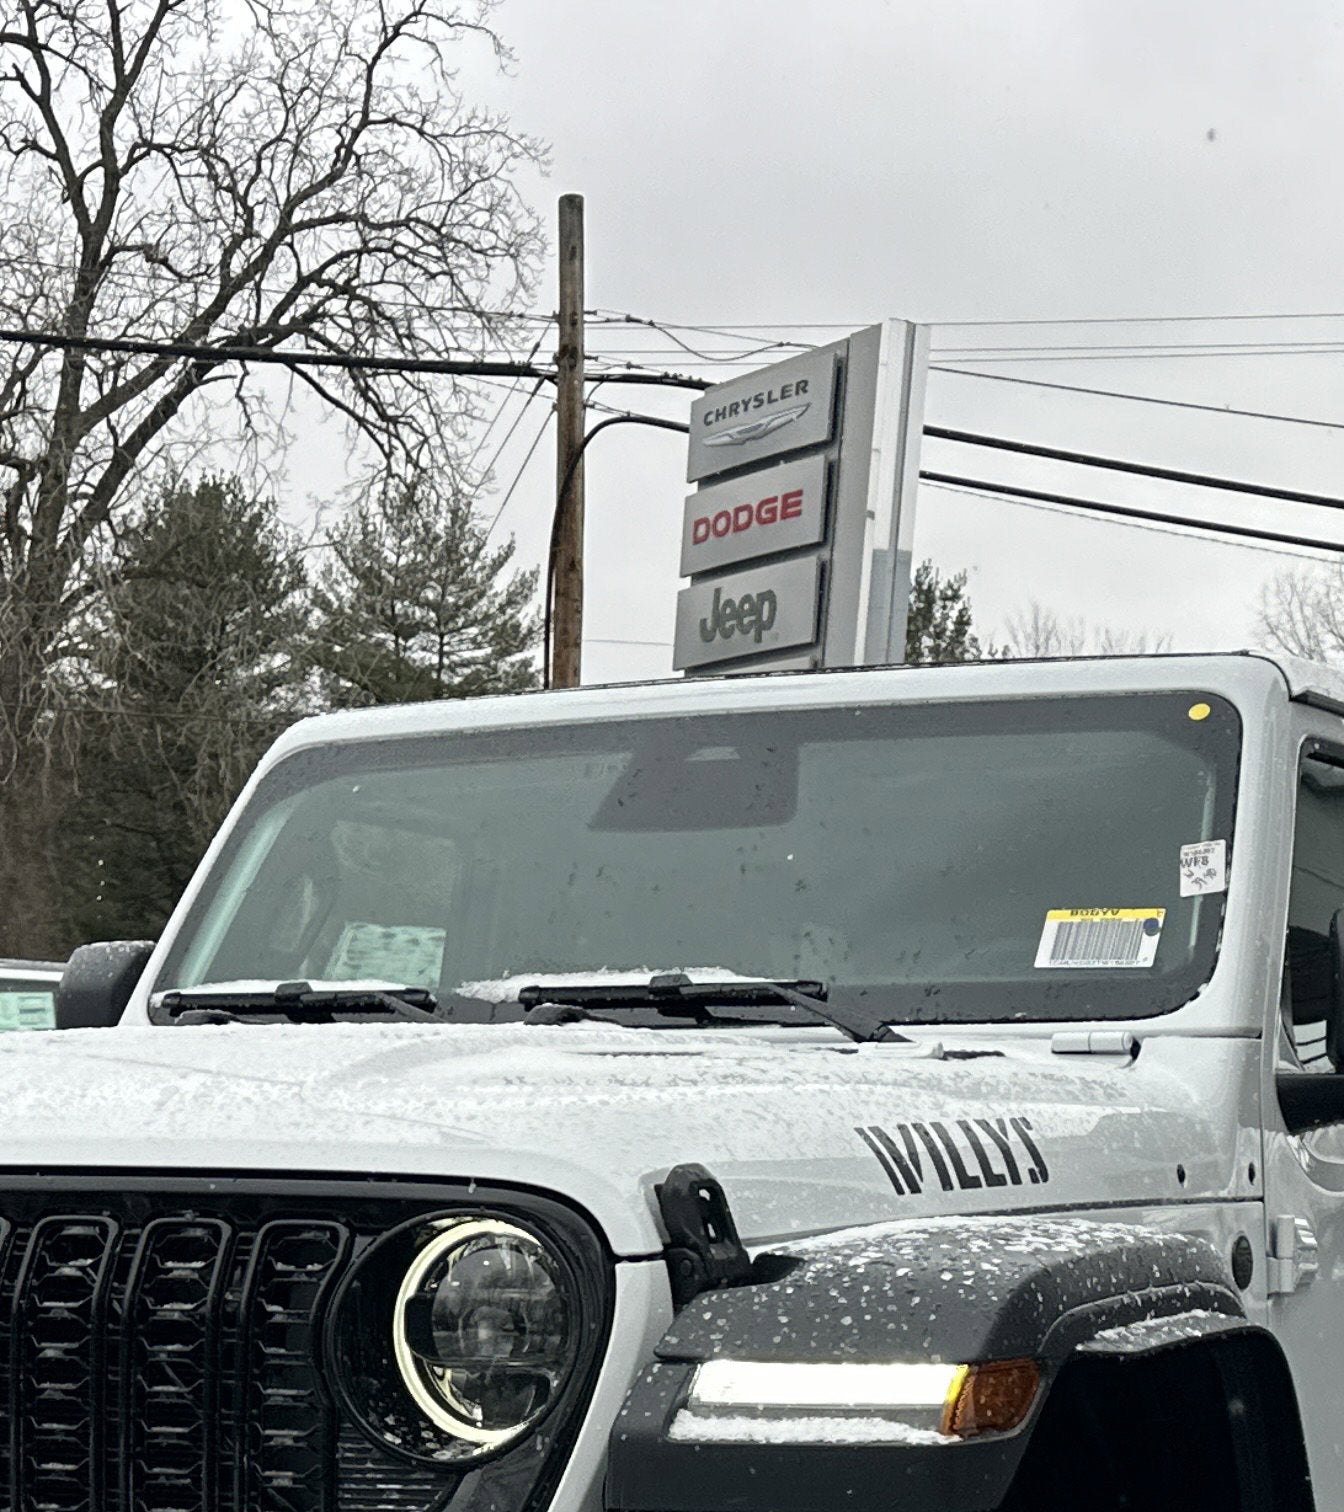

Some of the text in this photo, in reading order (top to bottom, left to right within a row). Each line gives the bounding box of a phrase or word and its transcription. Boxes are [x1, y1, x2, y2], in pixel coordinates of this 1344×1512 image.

[703, 378, 809, 427] CHRYSLER
[692, 489, 804, 545] DODGE
[699, 587, 778, 643] Jeep
[853, 1116, 1050, 1196] WILLYS
